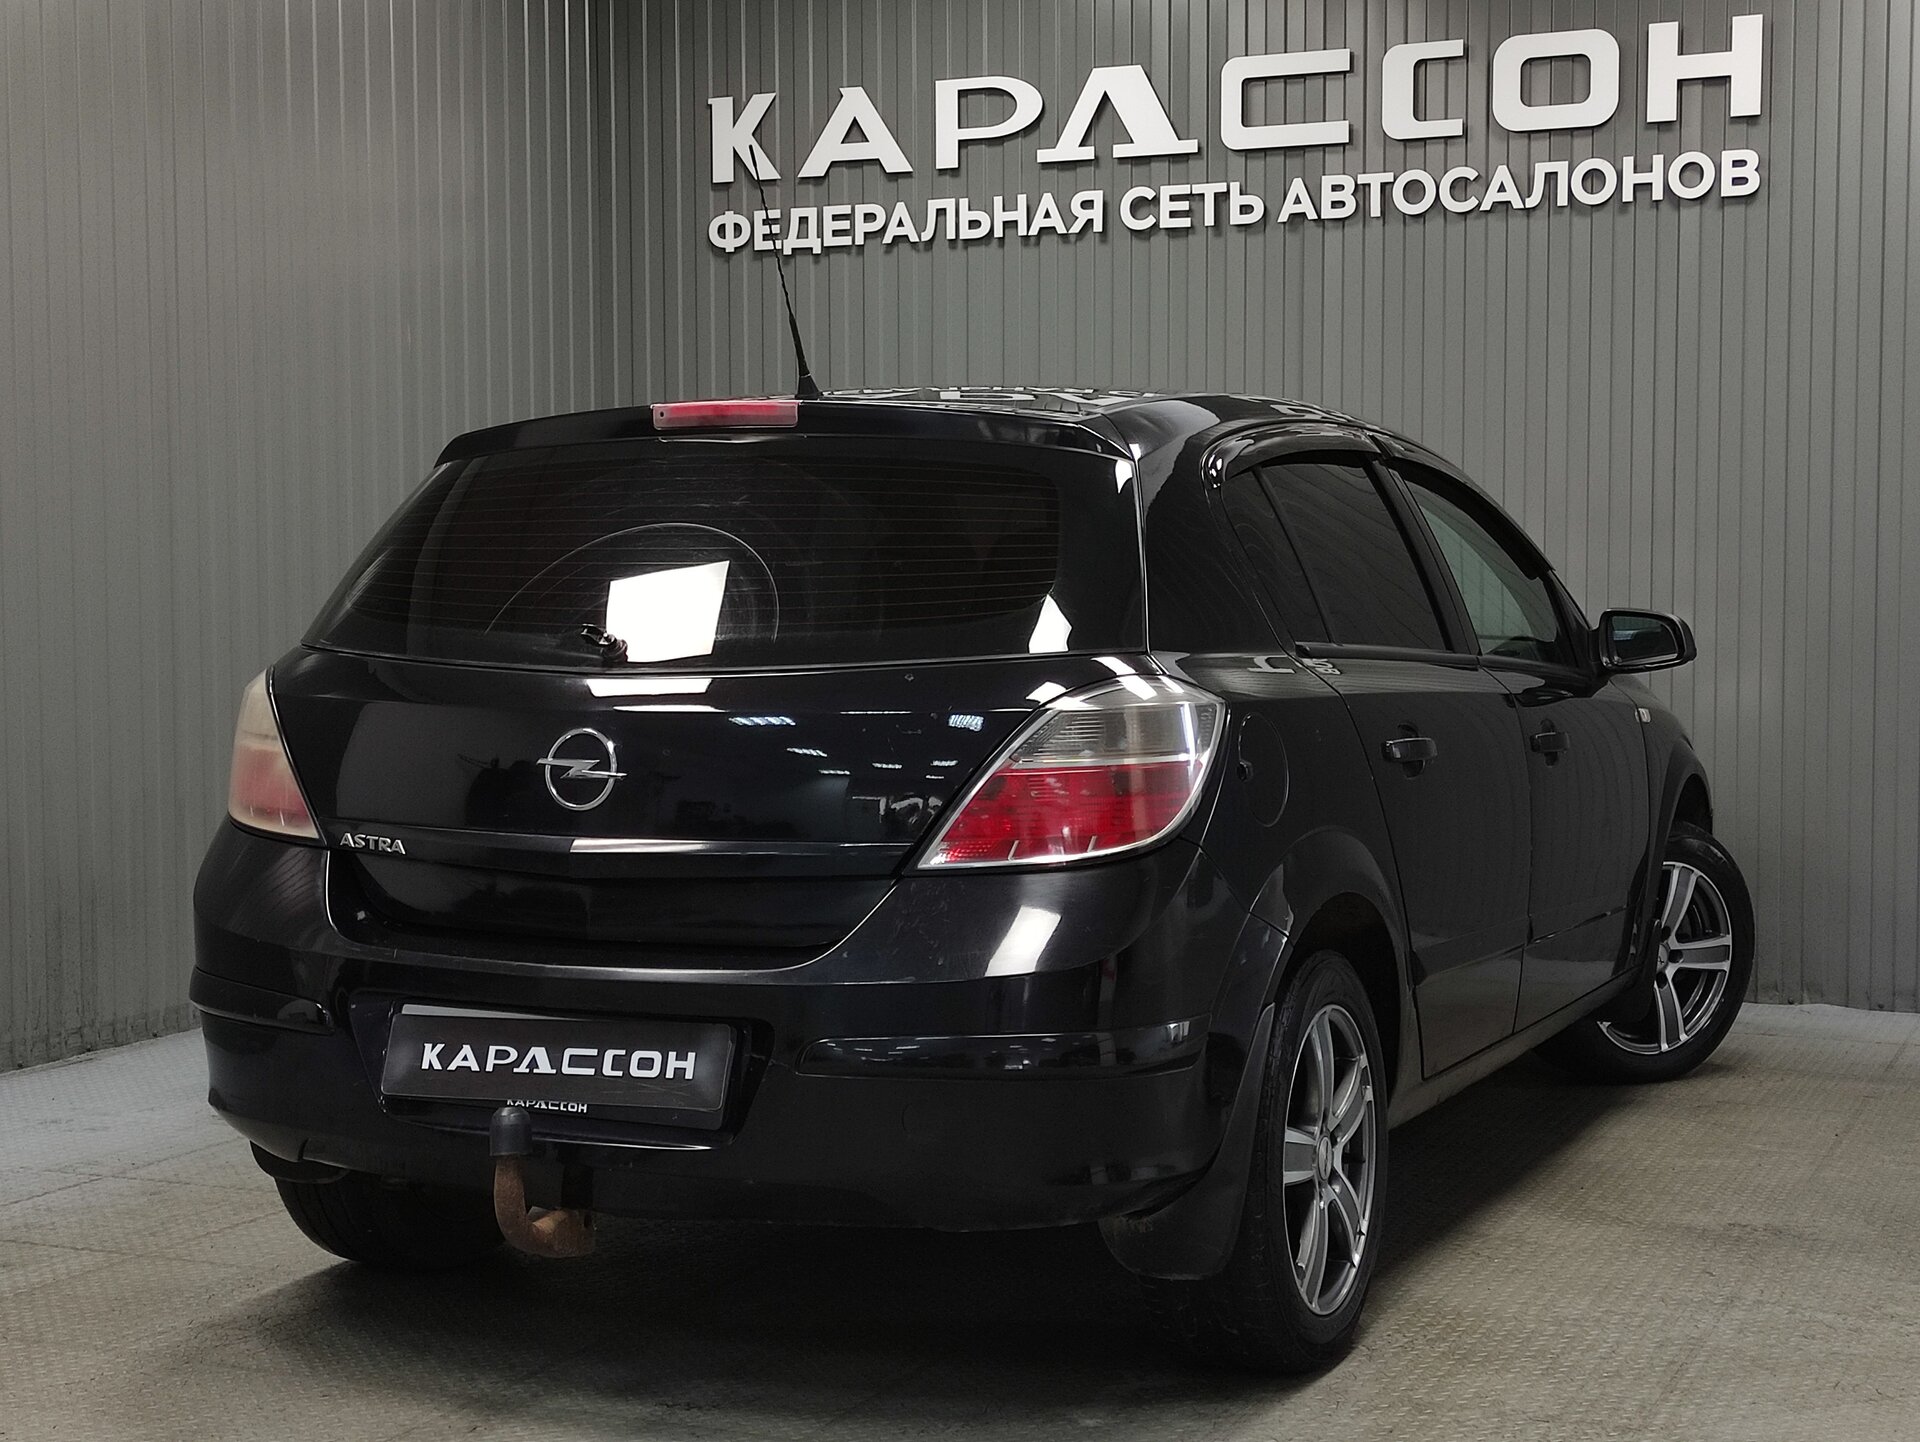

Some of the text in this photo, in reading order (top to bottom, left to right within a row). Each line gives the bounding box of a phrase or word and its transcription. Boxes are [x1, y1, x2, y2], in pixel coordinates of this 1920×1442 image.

[708, 149, 1761, 255] ФЕДЕРАЛЬНАЯ СЕТЬ АВТОСАЛОНОВ
[340, 832, 405, 854] ASTRA
